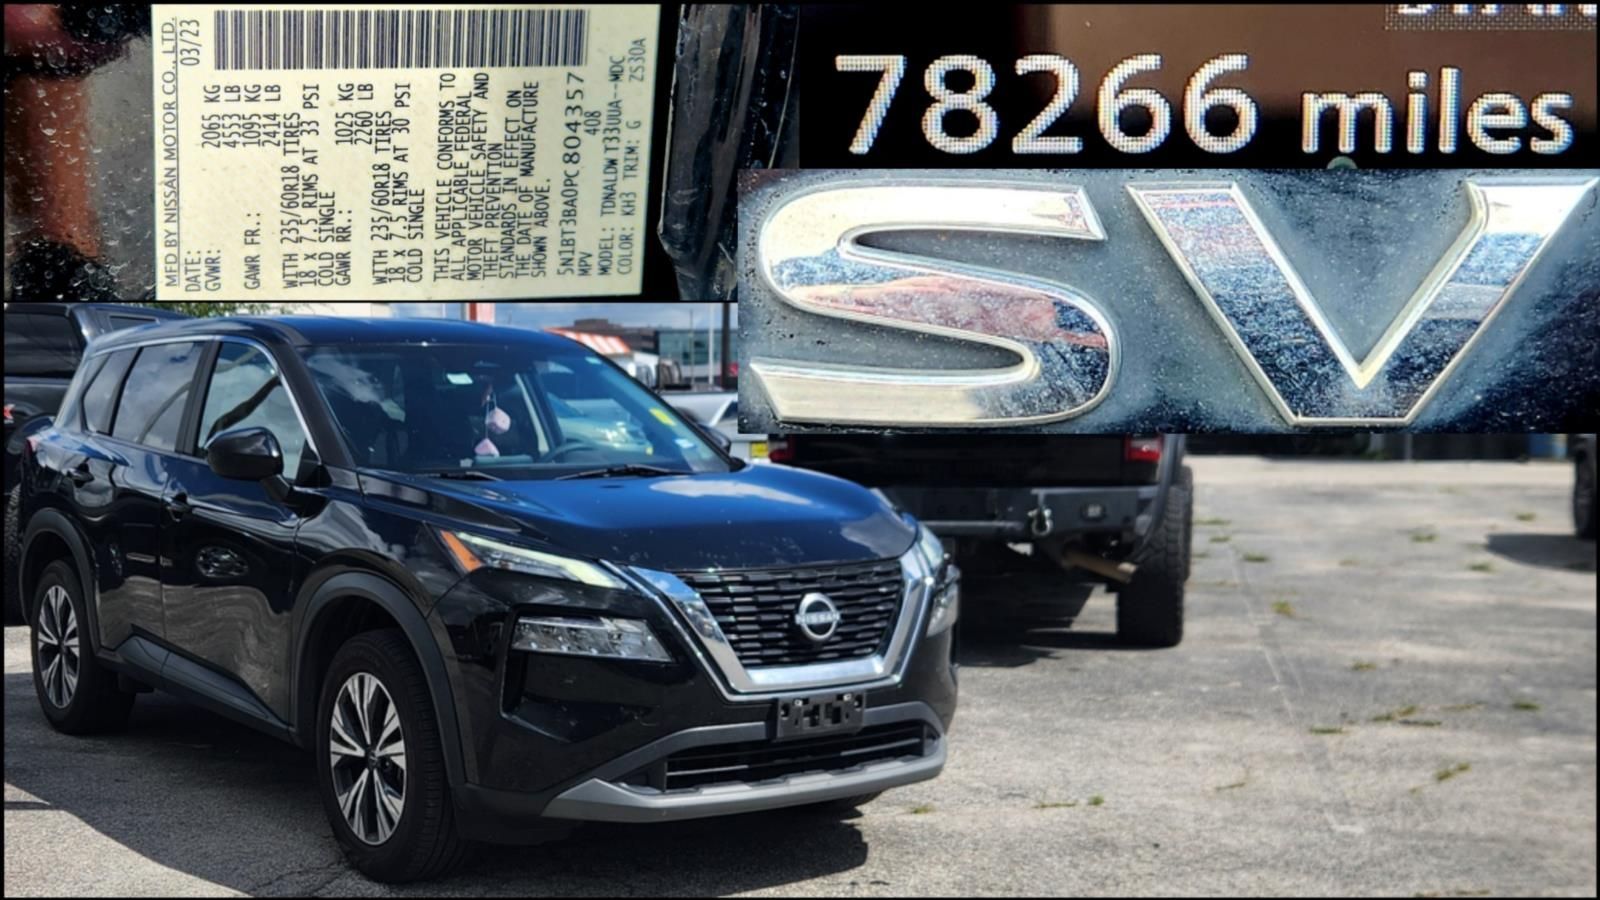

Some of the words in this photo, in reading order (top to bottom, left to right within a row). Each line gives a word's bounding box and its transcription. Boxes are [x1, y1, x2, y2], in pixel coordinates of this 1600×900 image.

[162, 17, 175, 54] LTD.
[180, 19, 202, 66] 03/23
[204, 85, 220, 103] KG
[225, 86, 240, 102] LB
[245, 84, 261, 102] KG
[265, 85, 280, 102] LB
[304, 83, 318, 109] PSI
[338, 83, 354, 101] KG
[358, 84, 373, 100] LB
[395, 83, 410, 107] PSI
[440, 73, 456, 90] TO
[474, 73, 488, 100] AND
[506, 90, 521, 108] ON
[835, 54, 1259, 155] 78266
[1302, 66, 1575, 155] miles
[163, 102, 176, 160] MOTOR
[202, 114, 220, 148] 2065
[223, 113, 240, 148] 4553
[243, 113, 261, 147] 1095
[263, 113, 281, 147] 2414
[284, 112, 300, 156] TIRES
[302, 120, 318, 136] 33
[336, 112, 354, 145] 1025
[355, 111, 373, 145] 2260
[375, 111, 391, 154] TIRES
[392, 118, 410, 134] 30
[438, 100, 455, 170] CONFORMS
[455, 92, 471, 152] FEDERAL
[471, 110, 487, 160] SAFETY
[521, 82, 538, 177] MANUFACTURE
[584, 110, 601, 136] 408
[626, 120, 642, 129] G
[303, 147, 318, 165] AT
[393, 145, 409, 162] AT
[504, 118, 520, 168] EFFECT
[623, 140, 640, 180] TRIM:
[164, 167, 177, 223] NISSAN
[302, 174, 318, 208] RIMS
[371, 163, 391, 241] 235/60R18
[392, 172, 408, 206] RIMS
[469, 170, 486, 230] VEHICLE
[485, 143, 502, 228] PREVENTION
[503, 178, 518, 193] IN
[519, 186, 534, 202] OF
[281, 166, 301, 244] 235/60R18
[319, 192, 335, 243] SINGLE
[408, 189, 424, 240] SINGLE
[436, 180, 452, 239] VEHICLE
[452, 162, 469, 247] APPLICABLE
[534, 178, 551, 228] ABOVE.
[620, 192, 636, 216] KH3
[165, 229, 177, 247] BY
[245, 213, 261, 245] FR.:
[300, 219, 318, 244] 7.5
[337, 210, 352, 242] RR.:
[390, 215, 406, 240] 7.5
[500, 203, 517, 279] STANDARDS
[517, 212, 533, 245] DATE
[372, 250, 388, 285] WITH
[407, 249, 422, 283] COLD
[434, 248, 449, 282] THIS
[467, 238, 483, 280] MOTOR
[484, 238, 499, 280] THEFT
[516, 254, 531, 278] THE
[534, 236, 548, 277] SHOWN
[579, 252, 593, 276] MPV
[599, 227, 615, 275] MODEL:
[618, 227, 634, 274] COLOR:
[165, 254, 178, 287] MFD
[185, 250, 201, 292] DATE:
[205, 249, 221, 291] GVWR:
[244, 255, 260, 290] GAWR
[283, 254, 298, 288] WITH
[301, 270, 317, 287] 18
[318, 252, 334, 286] COLD
[336, 251, 351, 286] GAWR
[389, 267, 406, 283] 18
[451, 256, 466, 281] ALL
[750, 178, 1599, 426] SV
[795, 610, 841, 625] NISSAN
